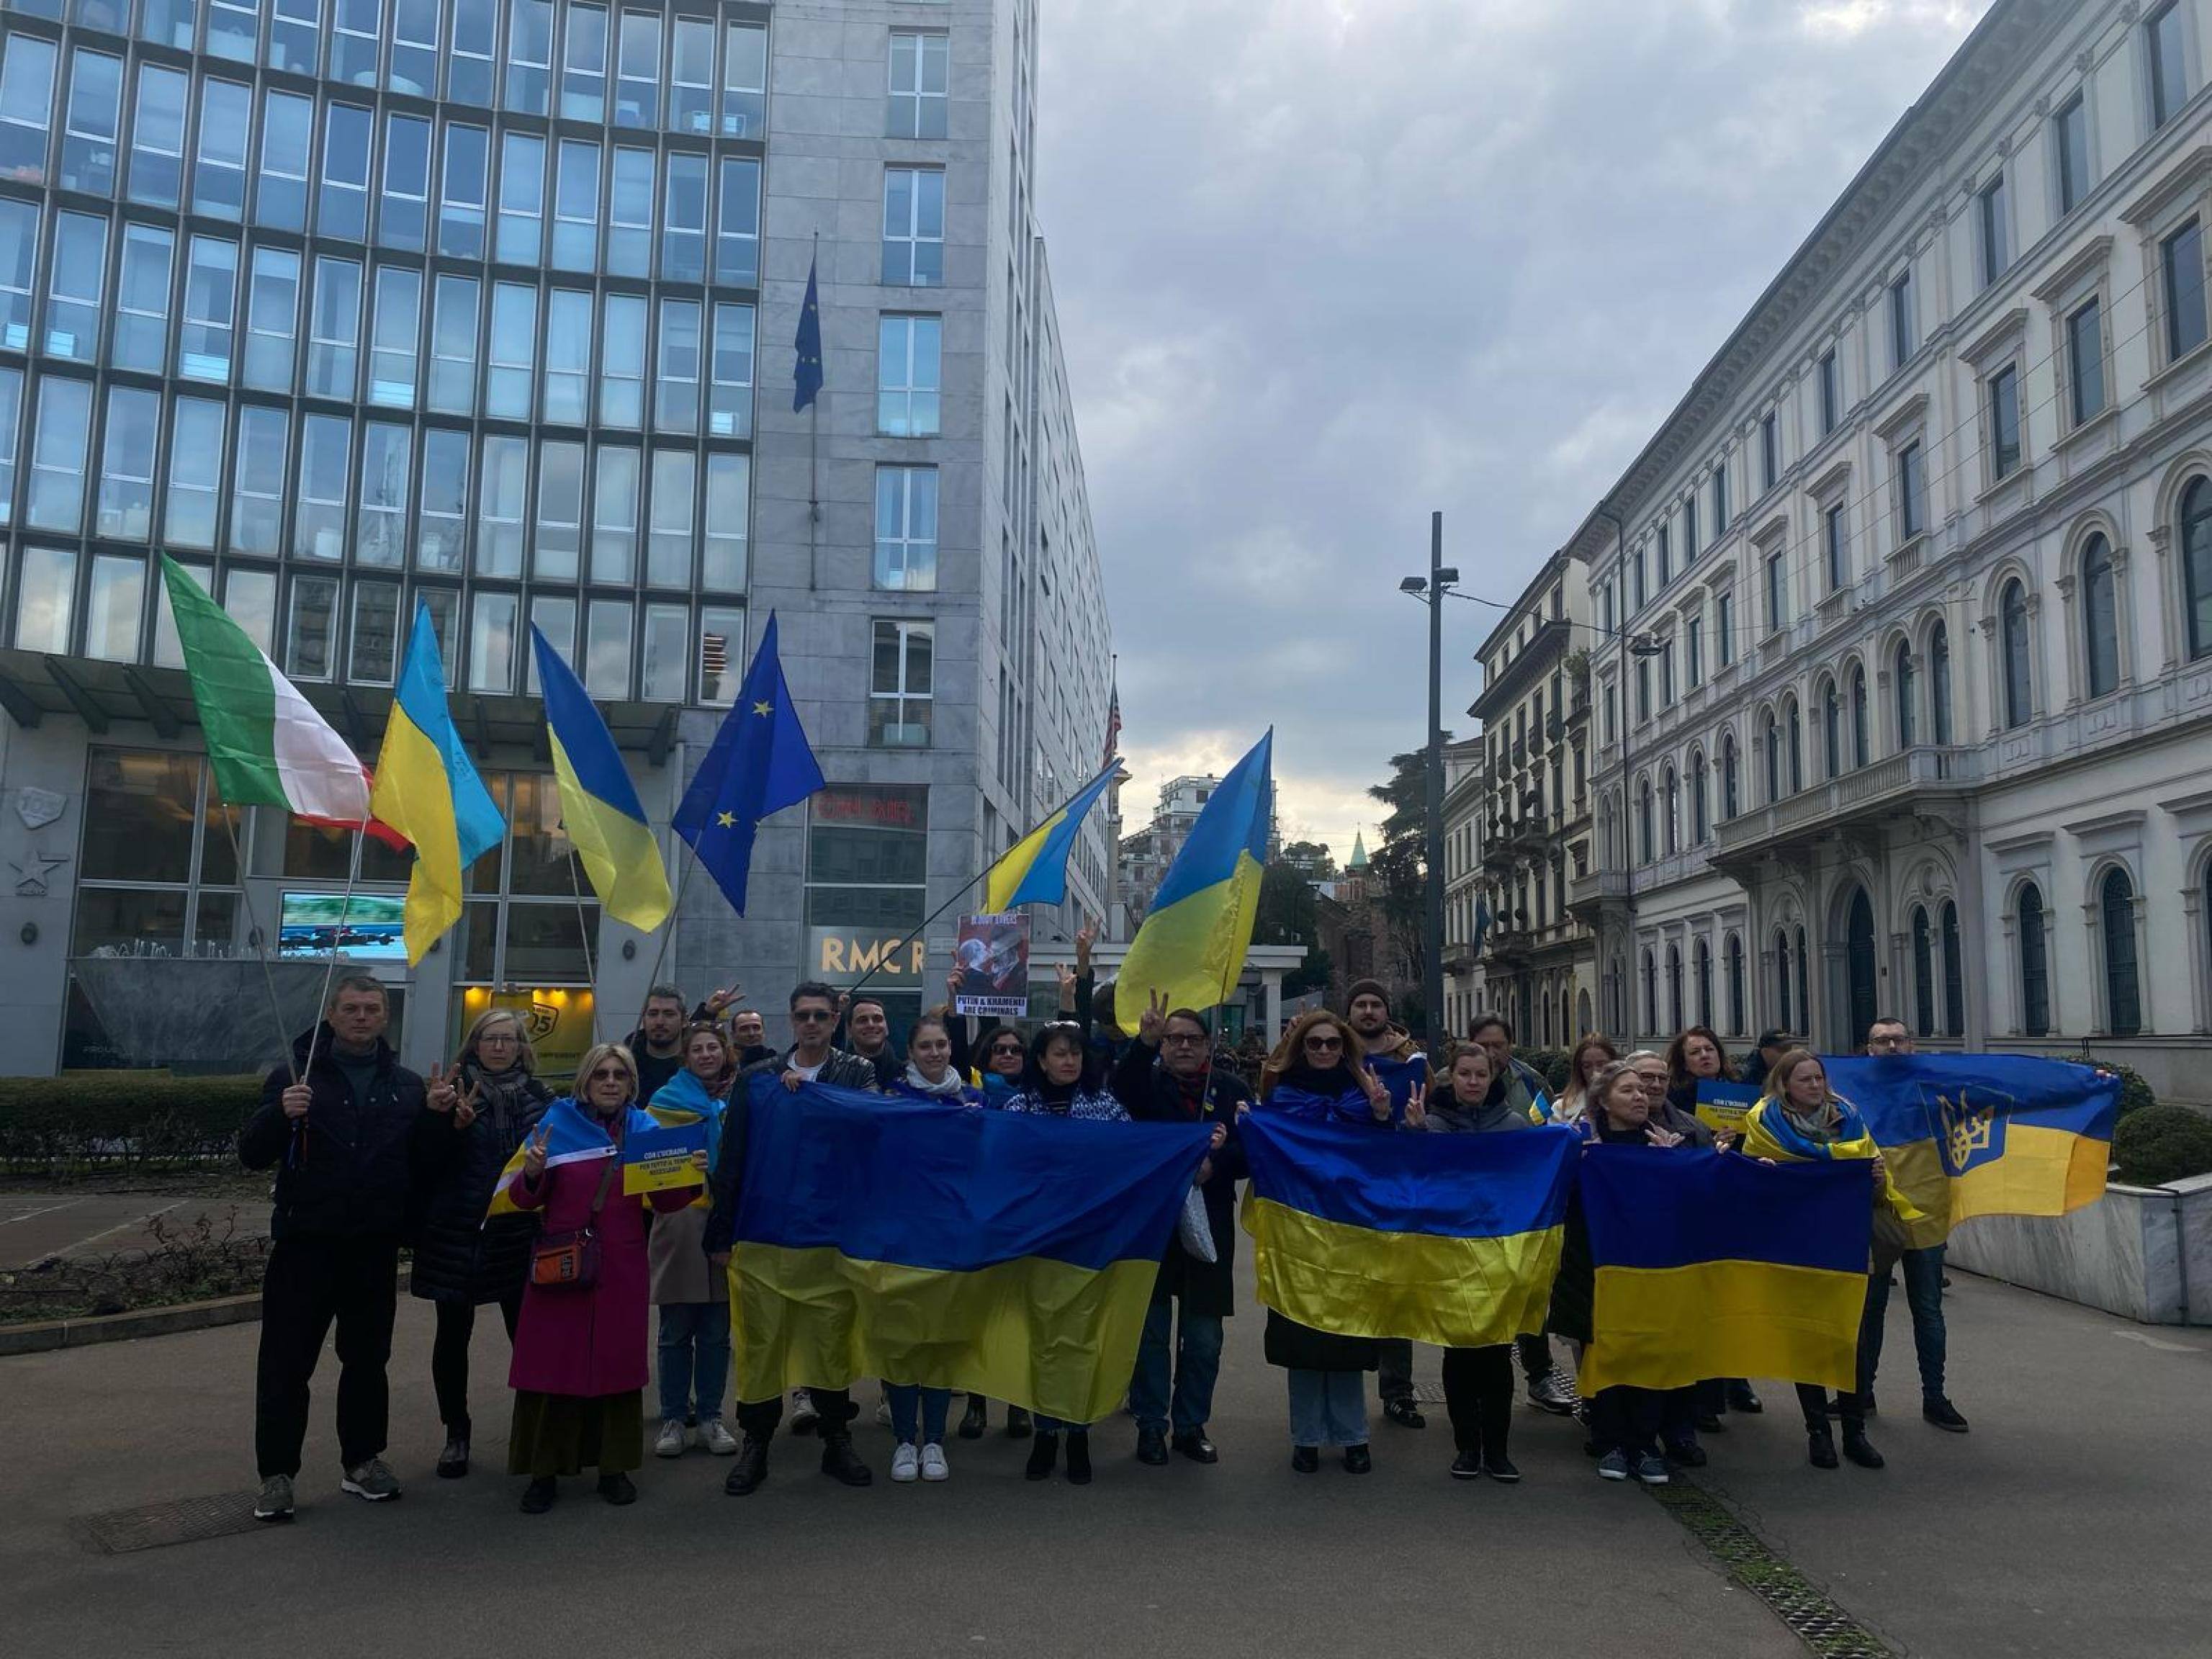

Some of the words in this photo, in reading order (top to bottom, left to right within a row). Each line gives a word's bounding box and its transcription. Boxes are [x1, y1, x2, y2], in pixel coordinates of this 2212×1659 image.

[822, 938, 901, 974] RMC
[958, 997, 978, 1005] PUTIN
[978, 1007, 1018, 1015] CRIMINALS
